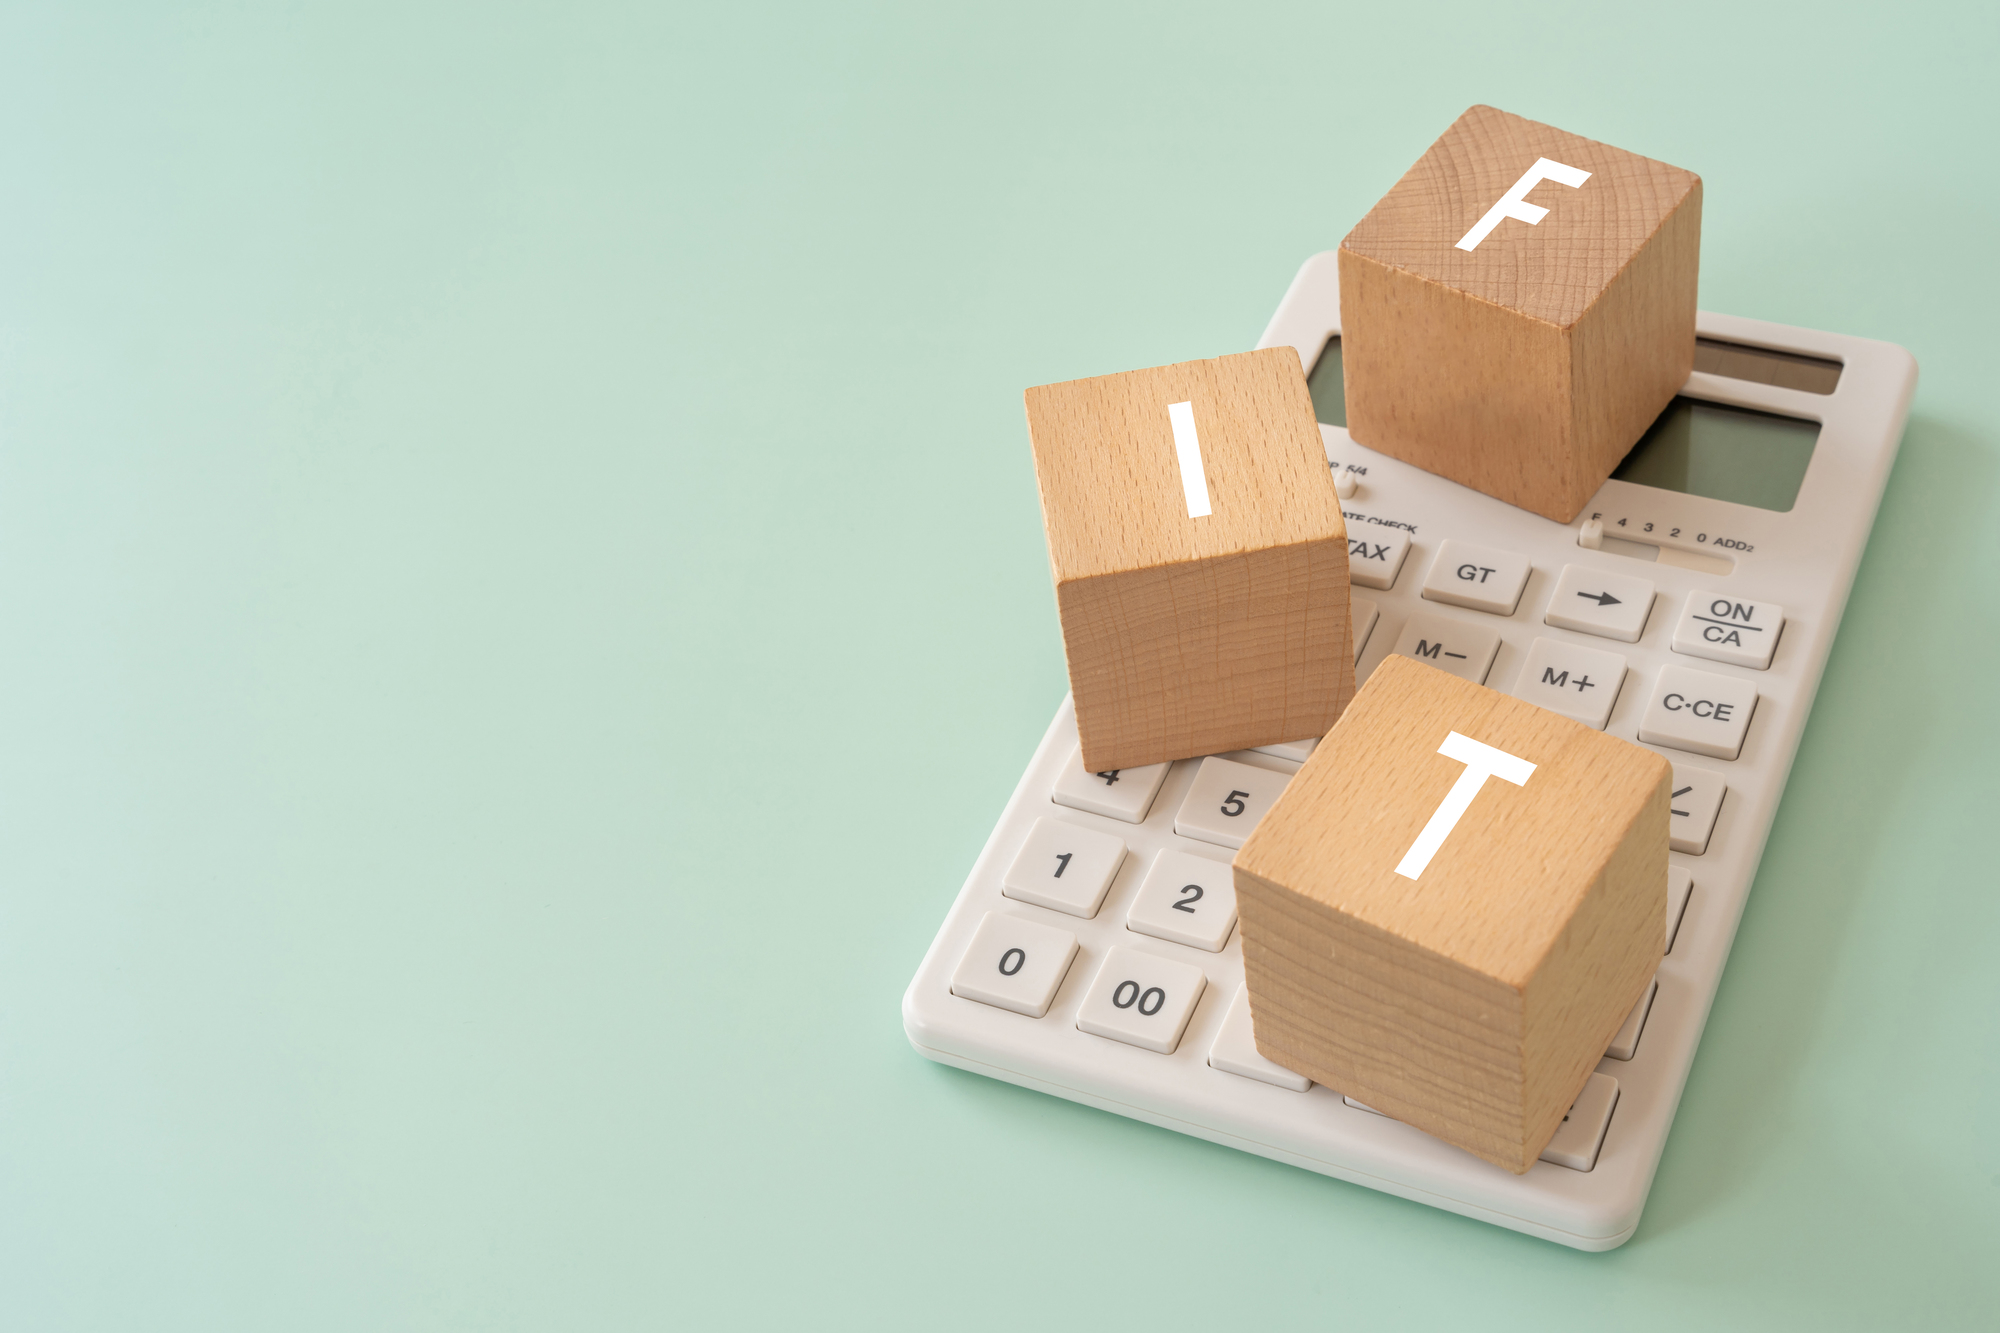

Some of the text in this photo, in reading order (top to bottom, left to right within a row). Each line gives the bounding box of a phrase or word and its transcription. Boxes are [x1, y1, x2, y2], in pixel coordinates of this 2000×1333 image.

[1455, 157, 1592, 252] F
[1167, 400, 1213, 519] I
[1367, 516, 1418, 535] CHECK
[1617, 518, 1627, 527] 4
[1643, 522, 1654, 533] 3
[1670, 528, 1681, 538] 2
[1696, 533, 1707, 543] 0
[1347, 538, 1391, 561] TAX
[1456, 564, 1497, 585] GT
[1710, 599, 1755, 623] ON
[1702, 626, 1743, 648] CA
[1541, 666, 1596, 692] M+
[1220, 789, 1250, 817] 5
[1394, 730, 1538, 881] T
[1053, 852, 1073, 879] 1
[1171, 884, 1204, 914] 2
[998, 947, 1026, 976] 0
[1111, 980, 1166, 1016] 00
